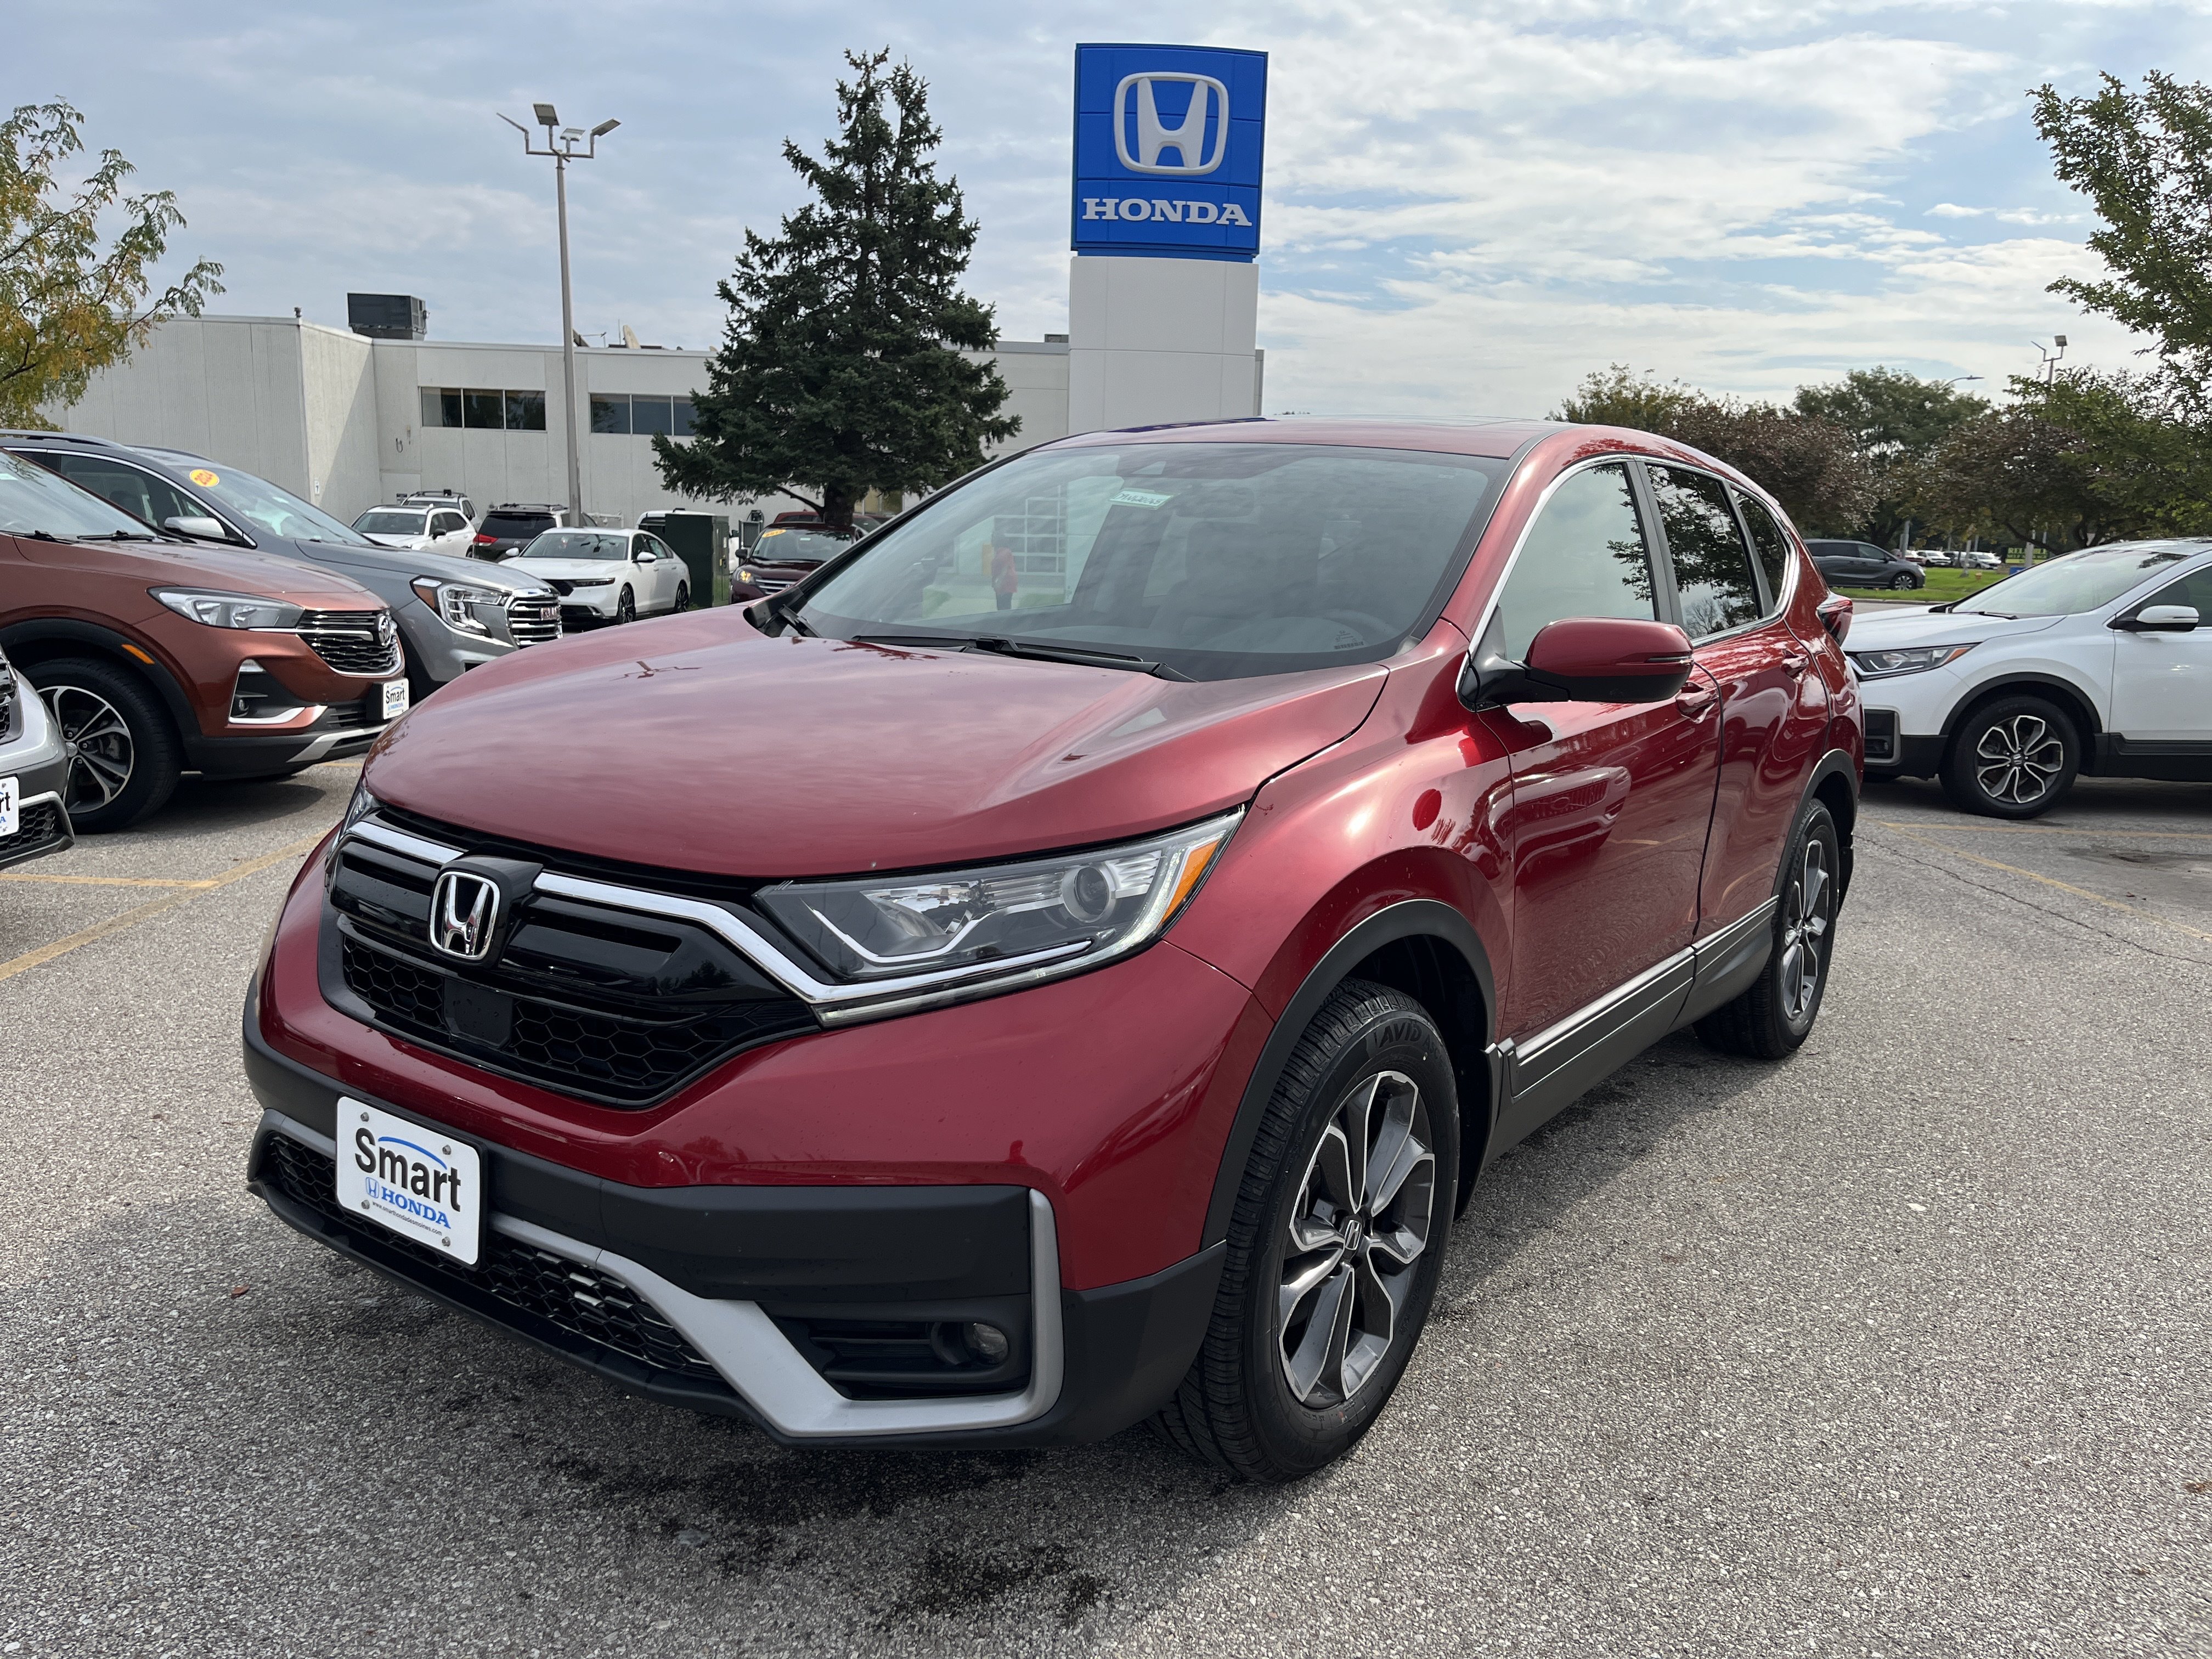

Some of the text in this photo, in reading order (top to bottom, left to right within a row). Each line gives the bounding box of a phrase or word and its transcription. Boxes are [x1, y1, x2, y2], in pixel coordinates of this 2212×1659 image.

[1082, 198, 1252, 226] HONDA
[386, 688, 405, 704] Smart
[1379, 1022, 1422, 1048] AVID
[355, 1127, 461, 1212] Smart
[381, 1186, 451, 1229] HONDA
